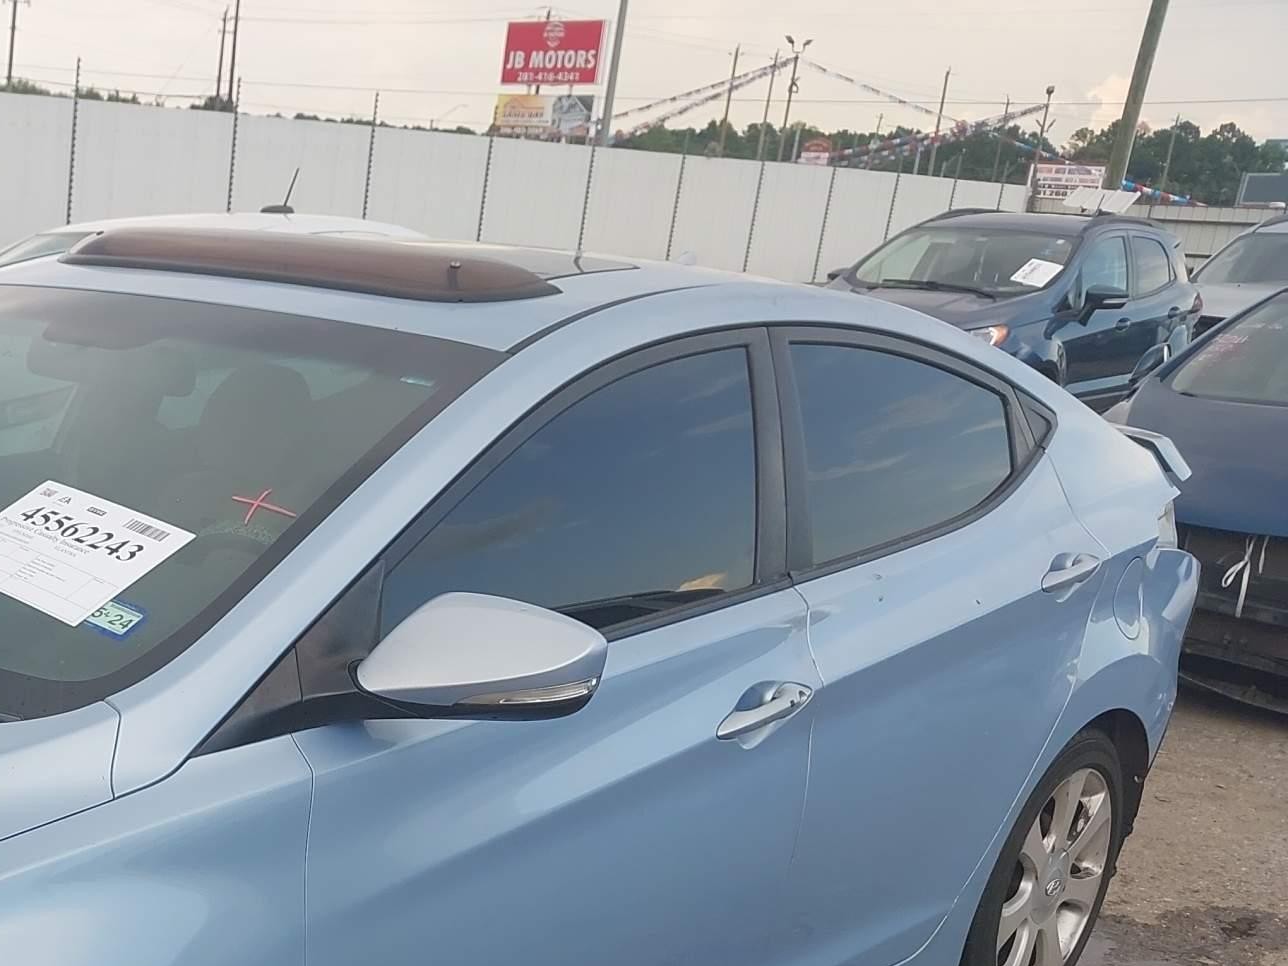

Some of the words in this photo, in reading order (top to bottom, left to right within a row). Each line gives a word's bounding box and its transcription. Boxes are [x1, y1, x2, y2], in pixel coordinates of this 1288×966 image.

[506, 50, 525, 69] JB
[528, 49, 596, 69] MOTORS
[20, 506, 145, 562] 45562243
[107, 613, 135, 630] 24
